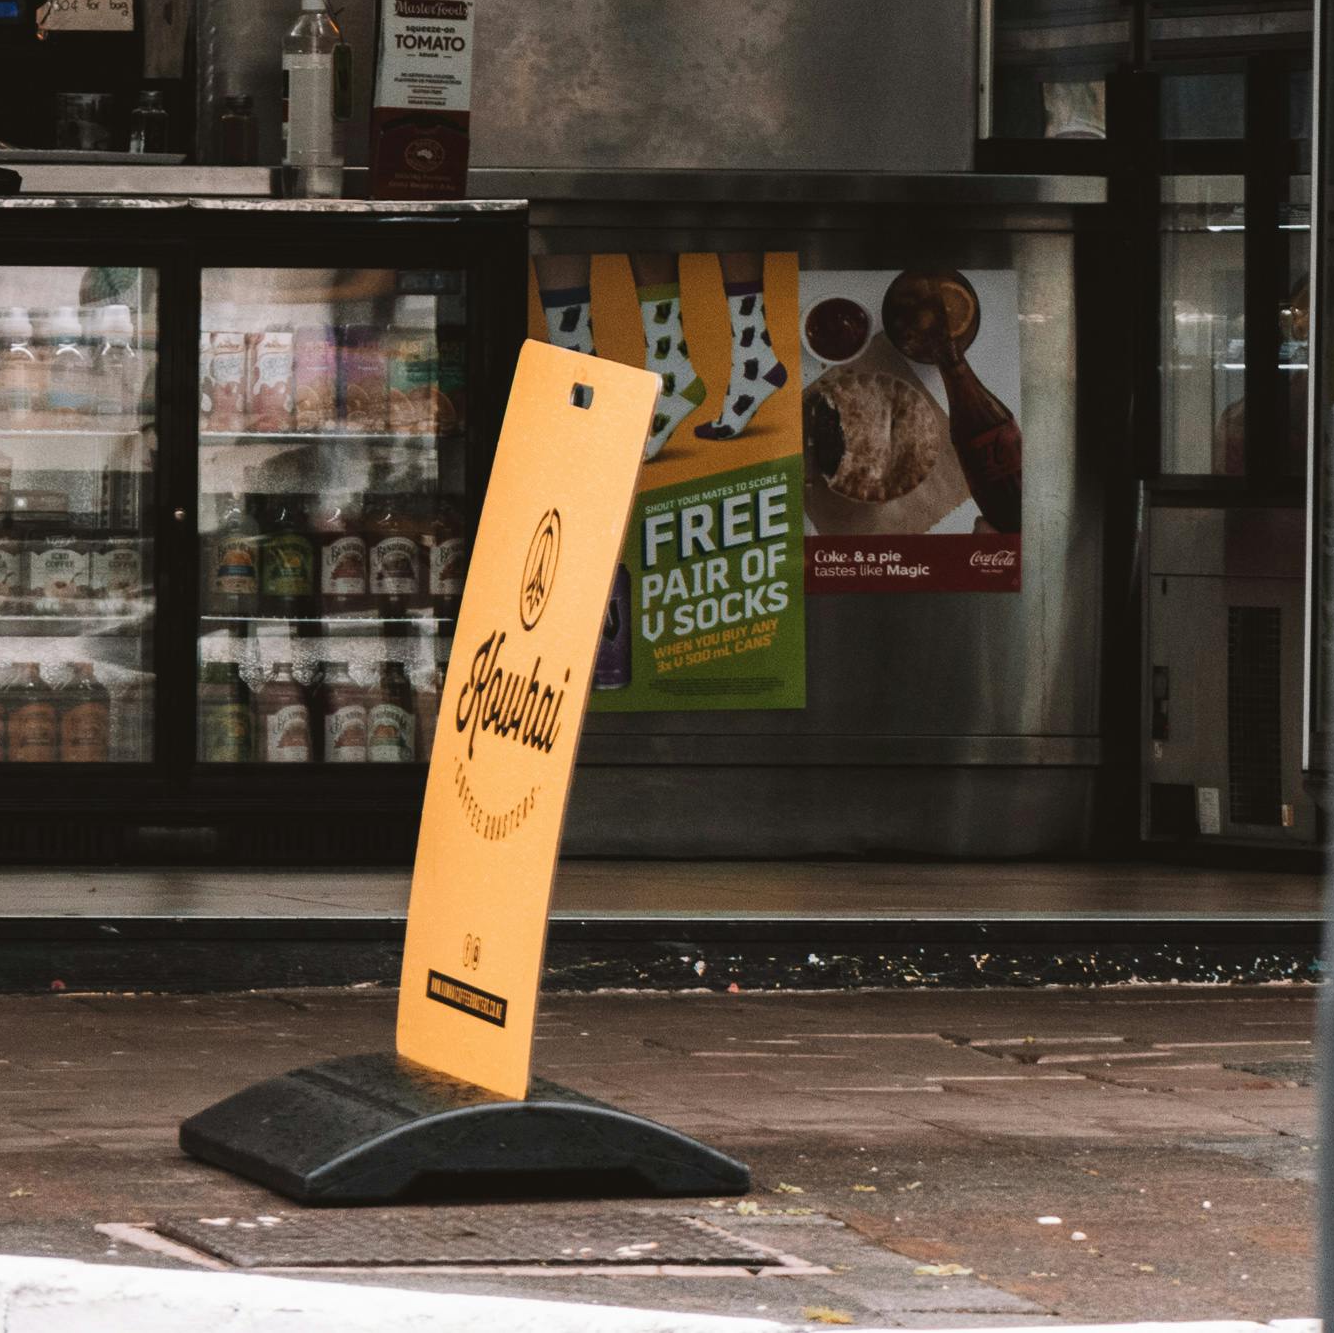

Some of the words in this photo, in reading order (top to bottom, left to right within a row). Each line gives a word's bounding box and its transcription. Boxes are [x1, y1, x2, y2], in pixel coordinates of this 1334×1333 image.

[395, 34, 466, 52] TOMATO
[644, 500, 675, 514] SHOUT
[677, 494, 701, 507] YOUR
[702, 486, 734, 501] MATES
[736, 481, 747, 492] TO
[748, 474, 778, 489] SCORE
[780, 472, 787, 481] A
[644, 483, 789, 567] FREE
[641, 556, 731, 610] PAIR
[740, 542, 787, 584] OF
[814, 550, 849, 563] Coke
[853, 550, 865, 562] &
[866, 552, 876, 562] a
[878, 550, 902, 565] pie
[814, 565, 857, 577] tastes
[860, 564, 884, 577] like
[886, 563, 931, 578] Magic
[641, 609, 665, 643] U
[673, 580, 789, 636] SOCKS
[653, 639, 693, 659] WHEN
[695, 632, 720, 648] YOU
[722, 625, 748, 643] BUY
[751, 618, 779, 636] ANY
[455, 629, 571, 762] Kowhai
